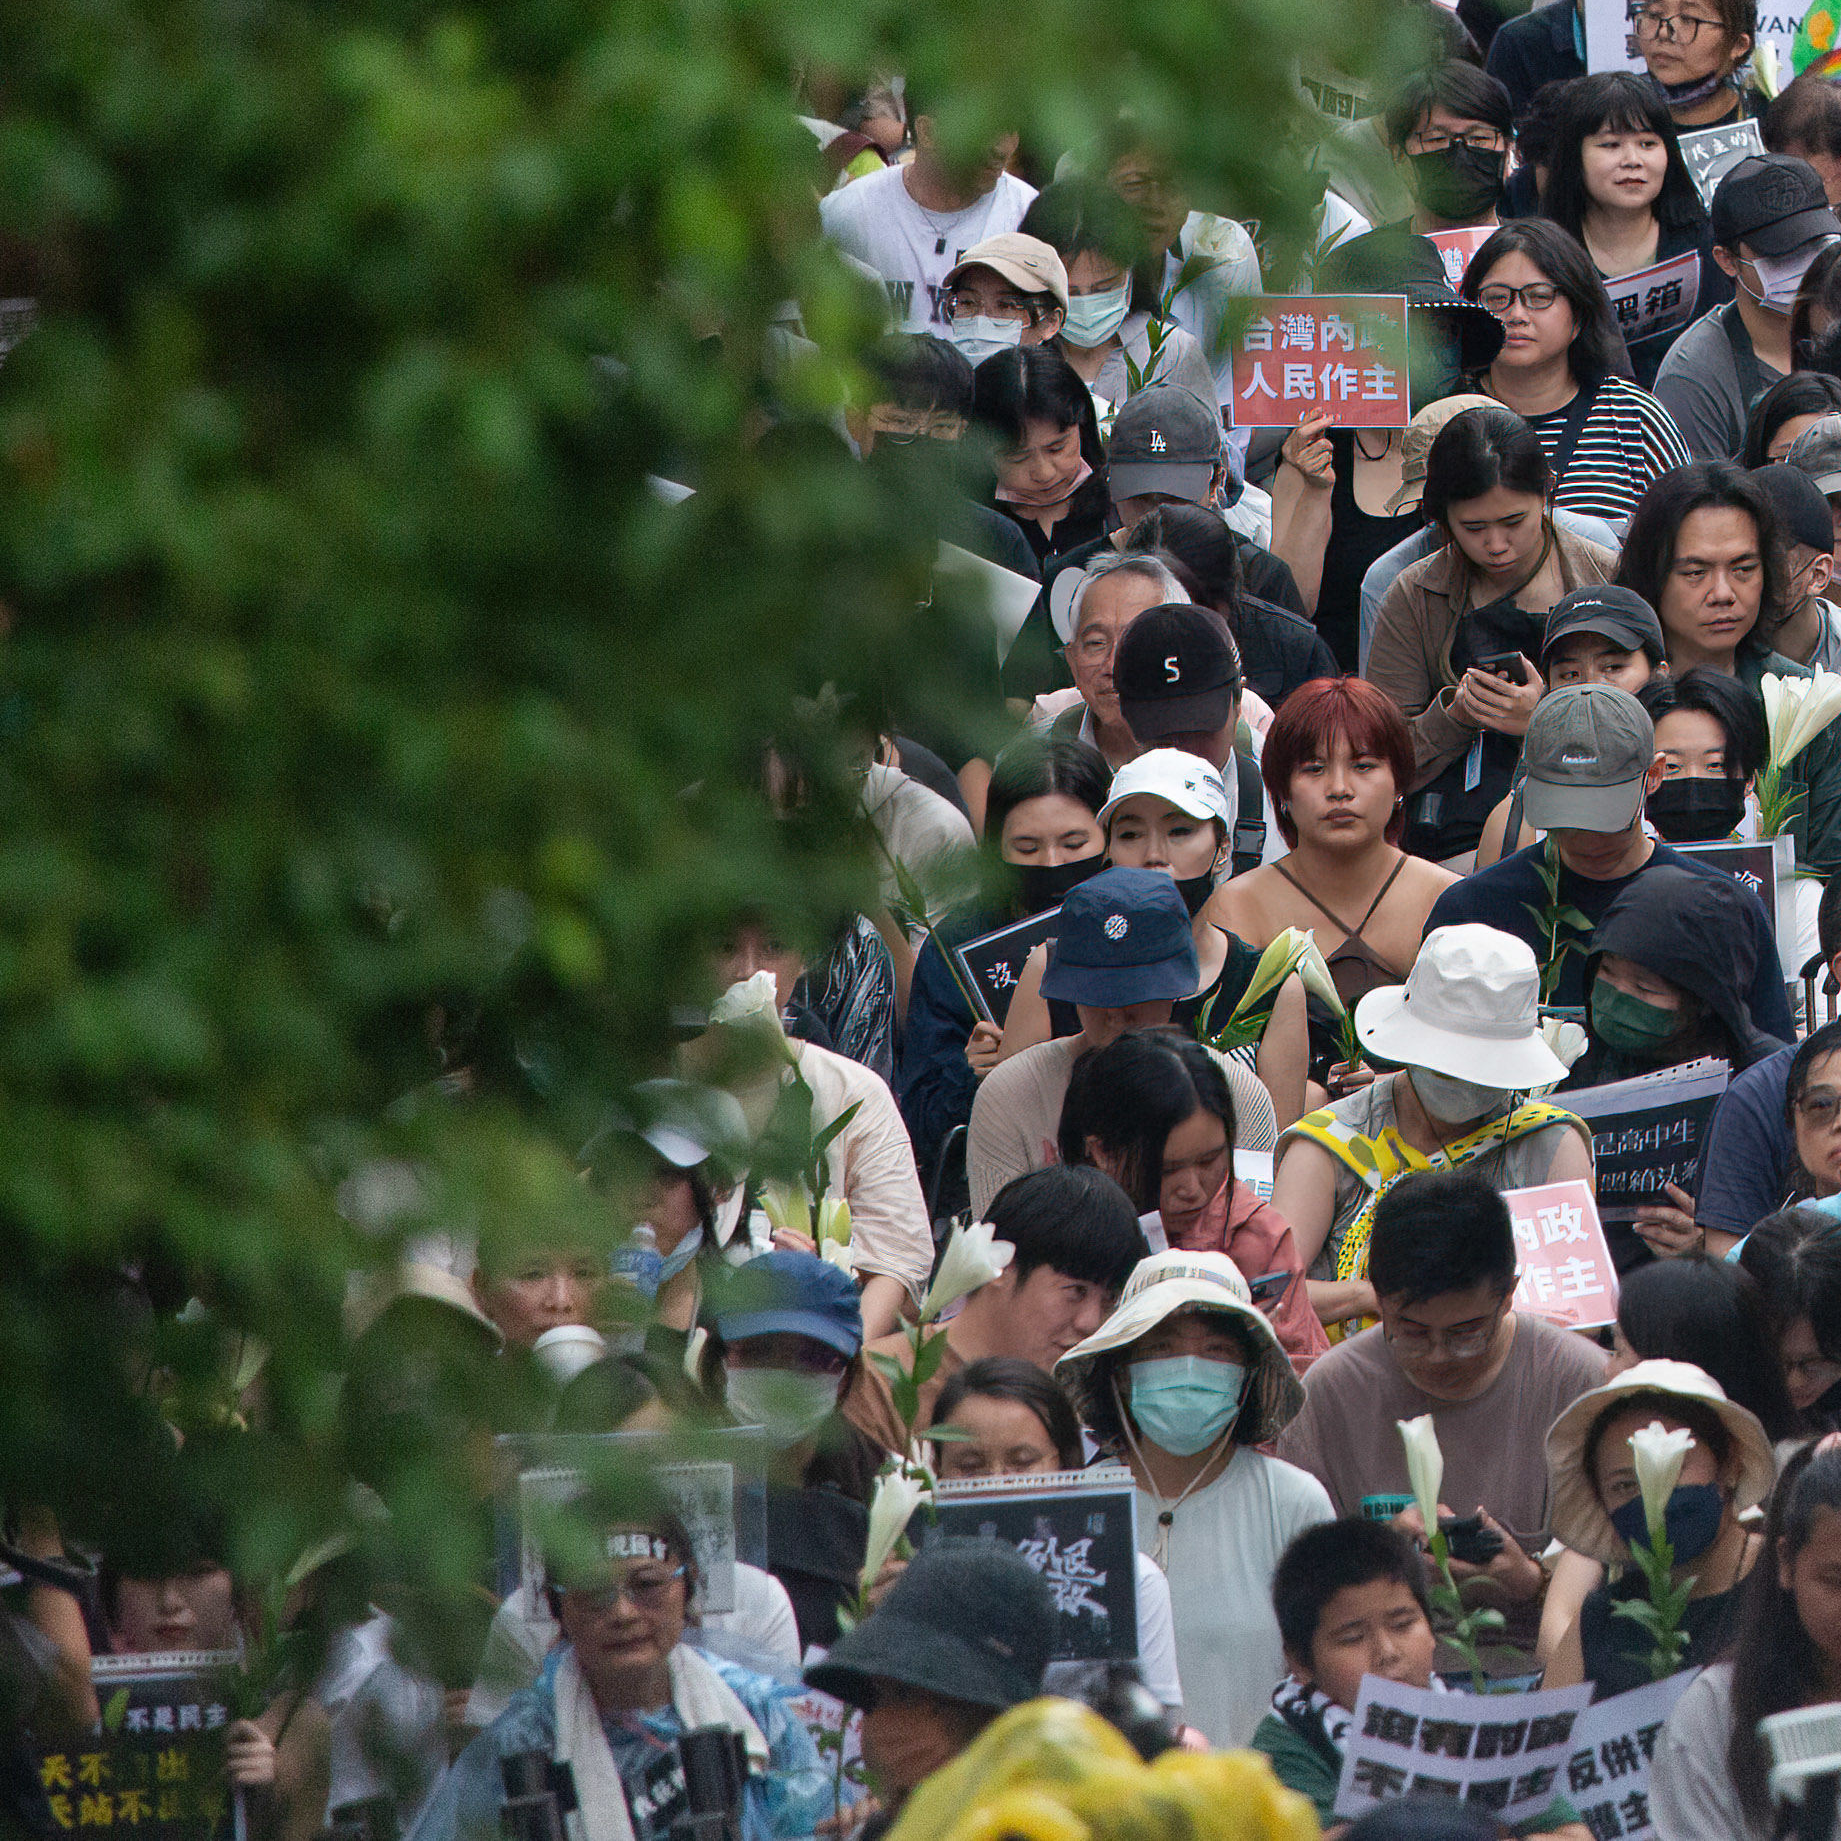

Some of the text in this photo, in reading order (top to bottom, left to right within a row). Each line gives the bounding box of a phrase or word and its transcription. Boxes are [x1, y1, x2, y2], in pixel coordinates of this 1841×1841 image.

[1242, 313, 1398, 354] 台灣內
[1241, 361, 1399, 401] 人民作主
[1150, 429, 1167, 453] LA
[1164, 656, 1181, 684] S
